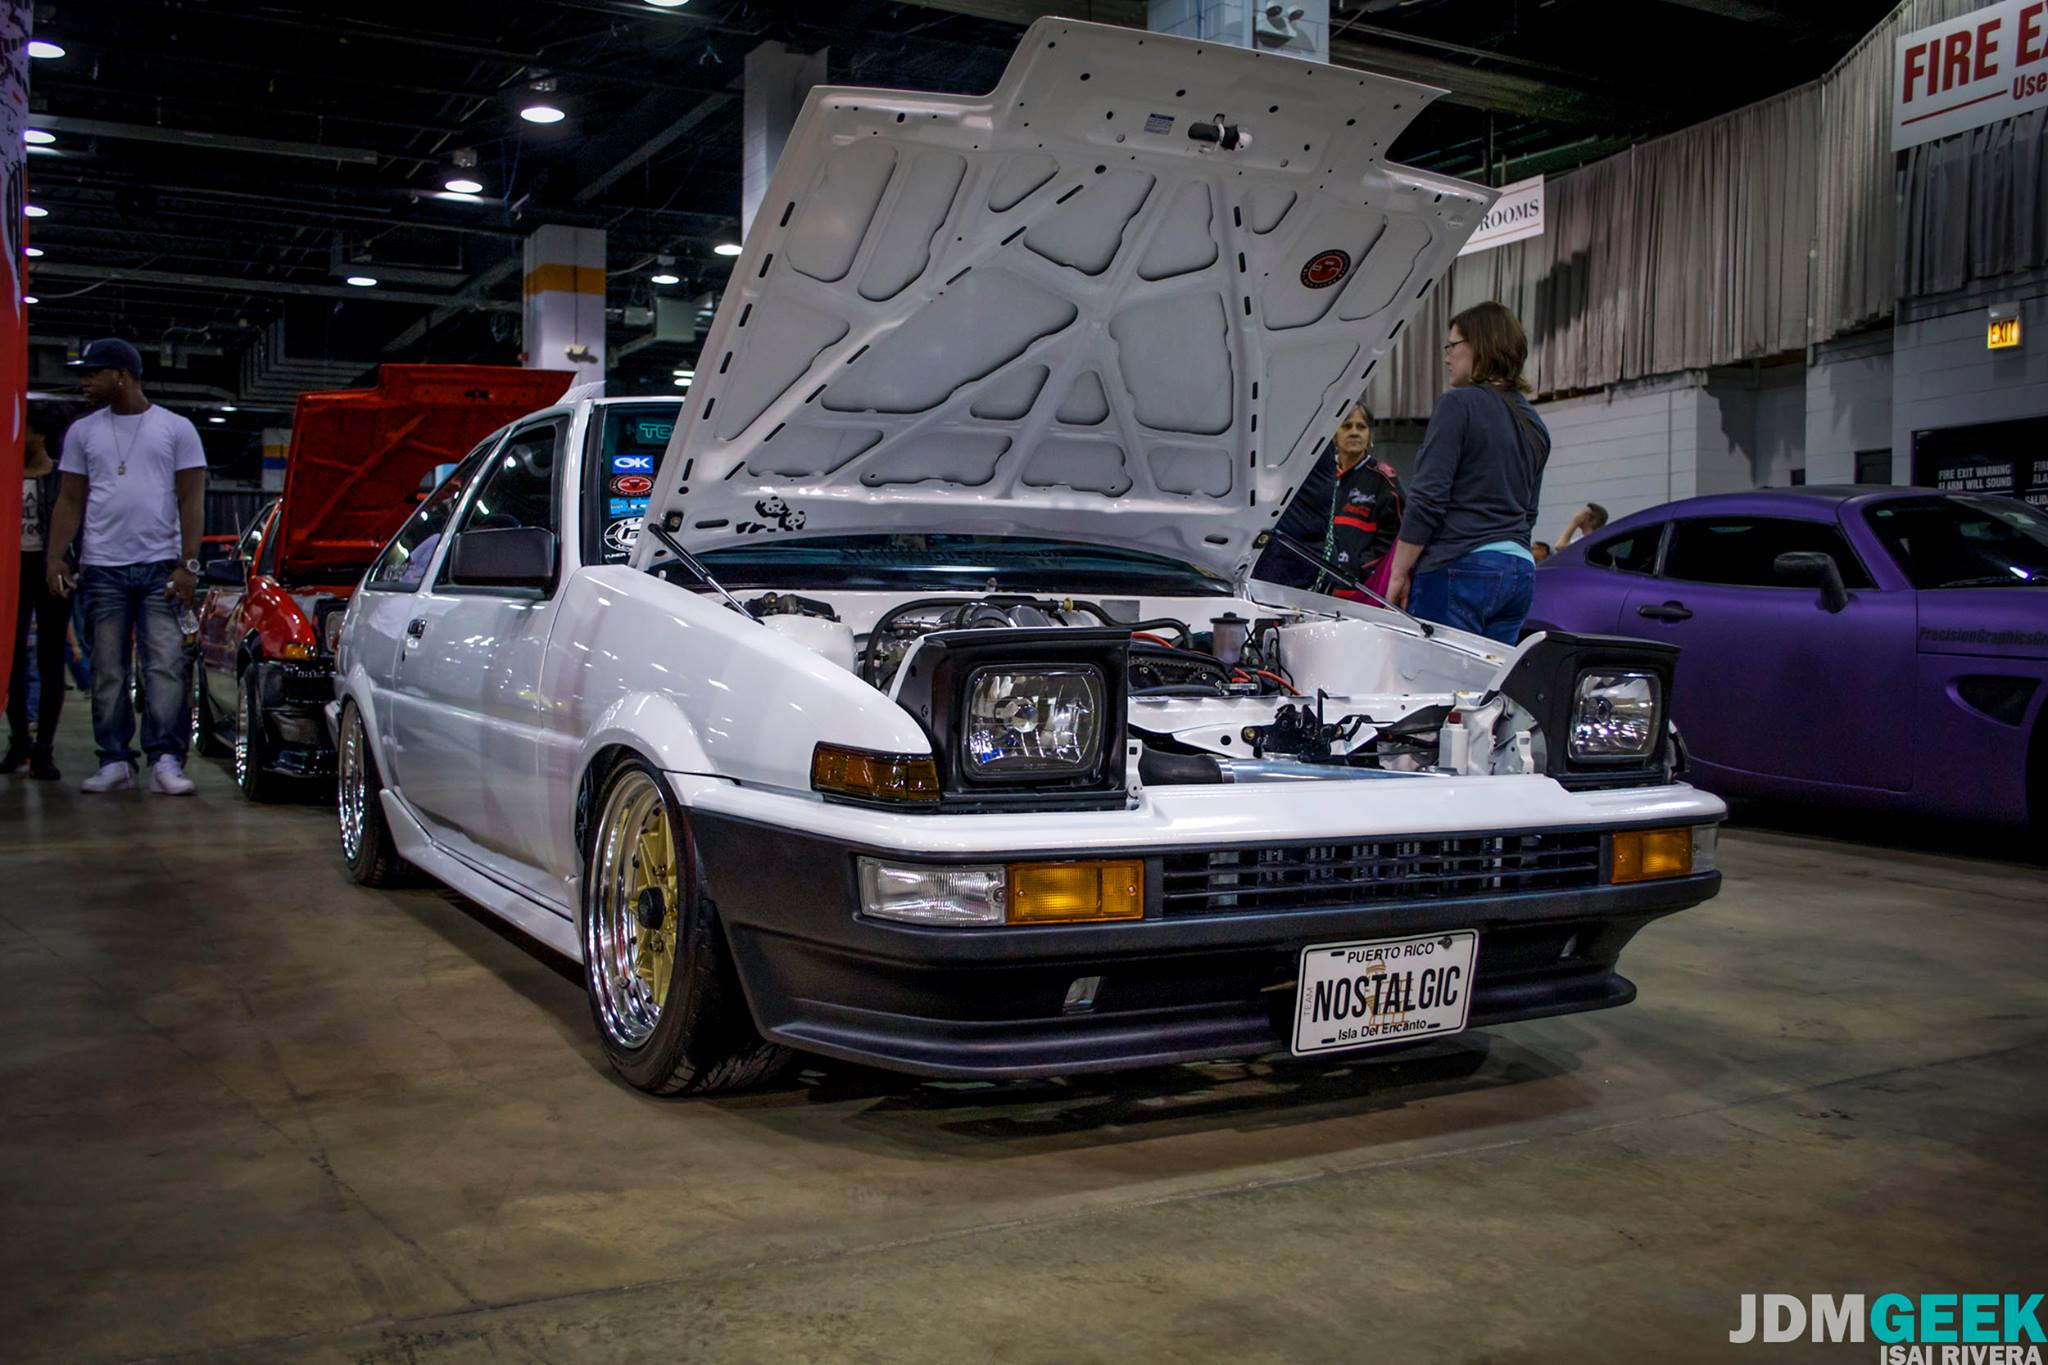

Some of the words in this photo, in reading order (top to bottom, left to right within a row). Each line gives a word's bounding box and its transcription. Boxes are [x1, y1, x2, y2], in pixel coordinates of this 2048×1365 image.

[1903, 17, 2002, 105] FIRE
[2013, 71, 2048, 101] Use
[1480, 199, 1540, 232] ROOMS
[1990, 319, 2016, 346] EXIT
[1938, 469, 1956, 480] FIRE
[1957, 467, 1974, 479] EXIT
[1976, 463, 2011, 477] WARNING
[1938, 479, 1964, 490] ALARM
[1966, 478, 1984, 490] WILL
[1985, 476, 2012, 489] SOUND
[1347, 948, 1401, 964] PUERTO
[1403, 942, 1435, 958] RICO
[1304, 986, 1313, 1017] TEAM
[1312, 965, 1461, 1023] NOSTALGIC
[1338, 1028, 1357, 1041] Isla
[1361, 1025, 1379, 1037] Del
[1382, 1019, 1427, 1036] Encanto
